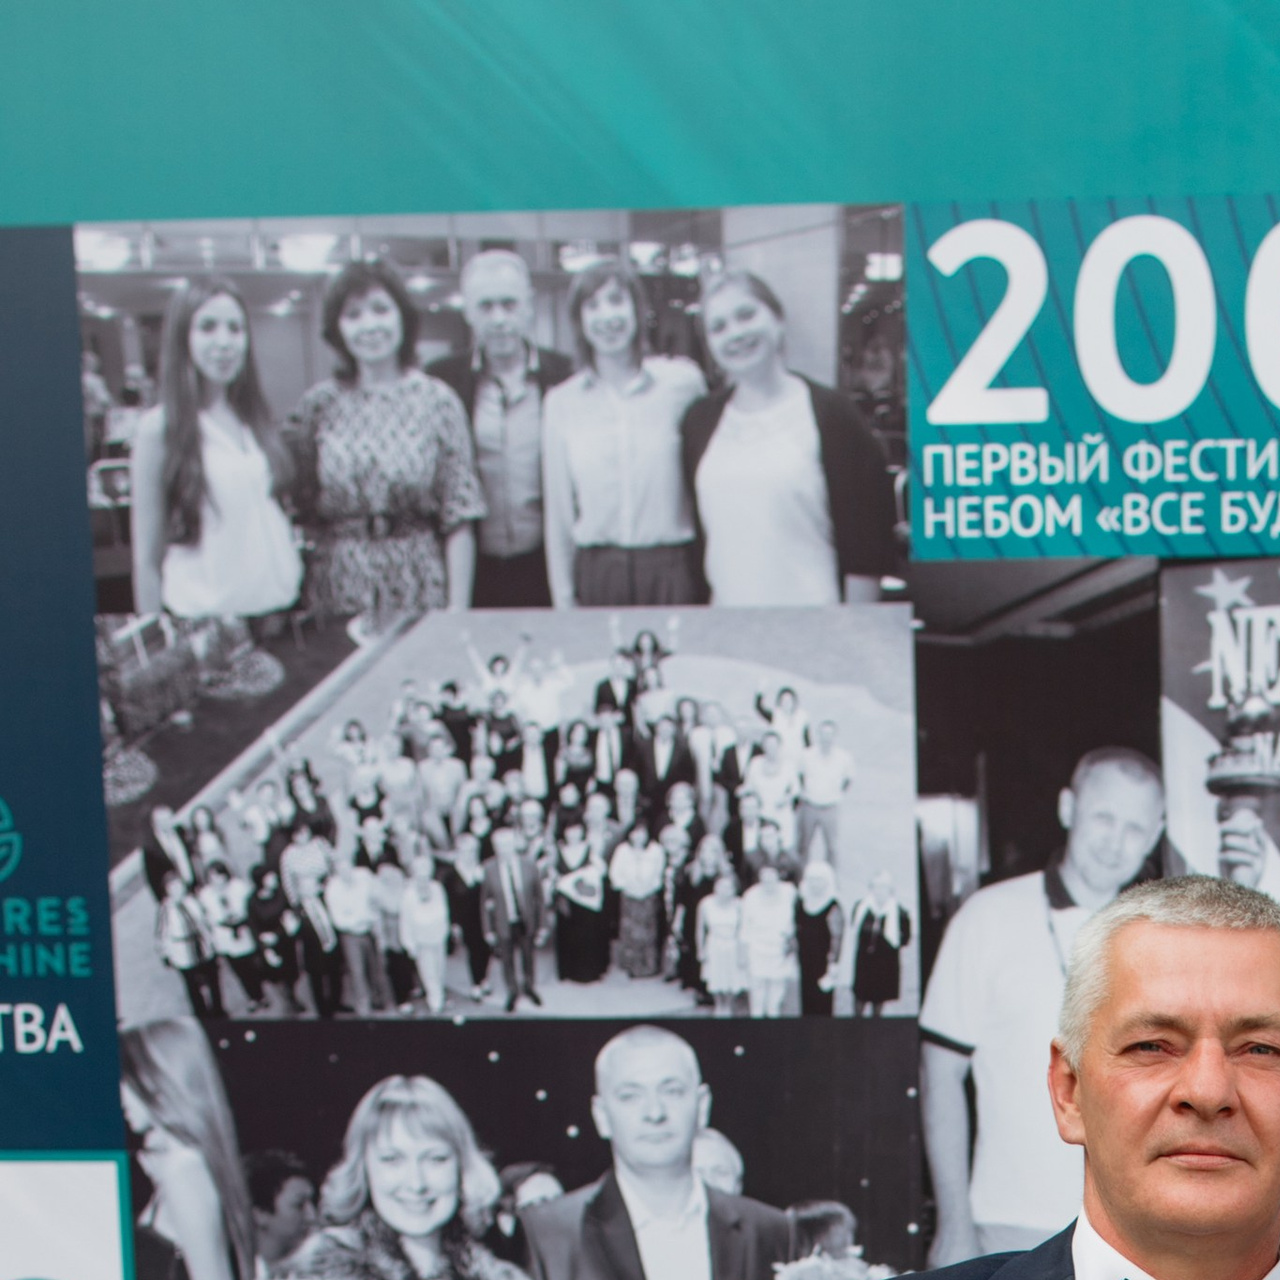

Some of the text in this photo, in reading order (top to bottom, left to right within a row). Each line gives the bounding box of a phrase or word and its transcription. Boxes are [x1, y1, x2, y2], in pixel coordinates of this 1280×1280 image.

[923, 434, 1108, 486] ПЕРВЫЙ
[924, 494, 1082, 537] НЕБОМ
[1097, 492, 1205, 535] «ВСЕ
